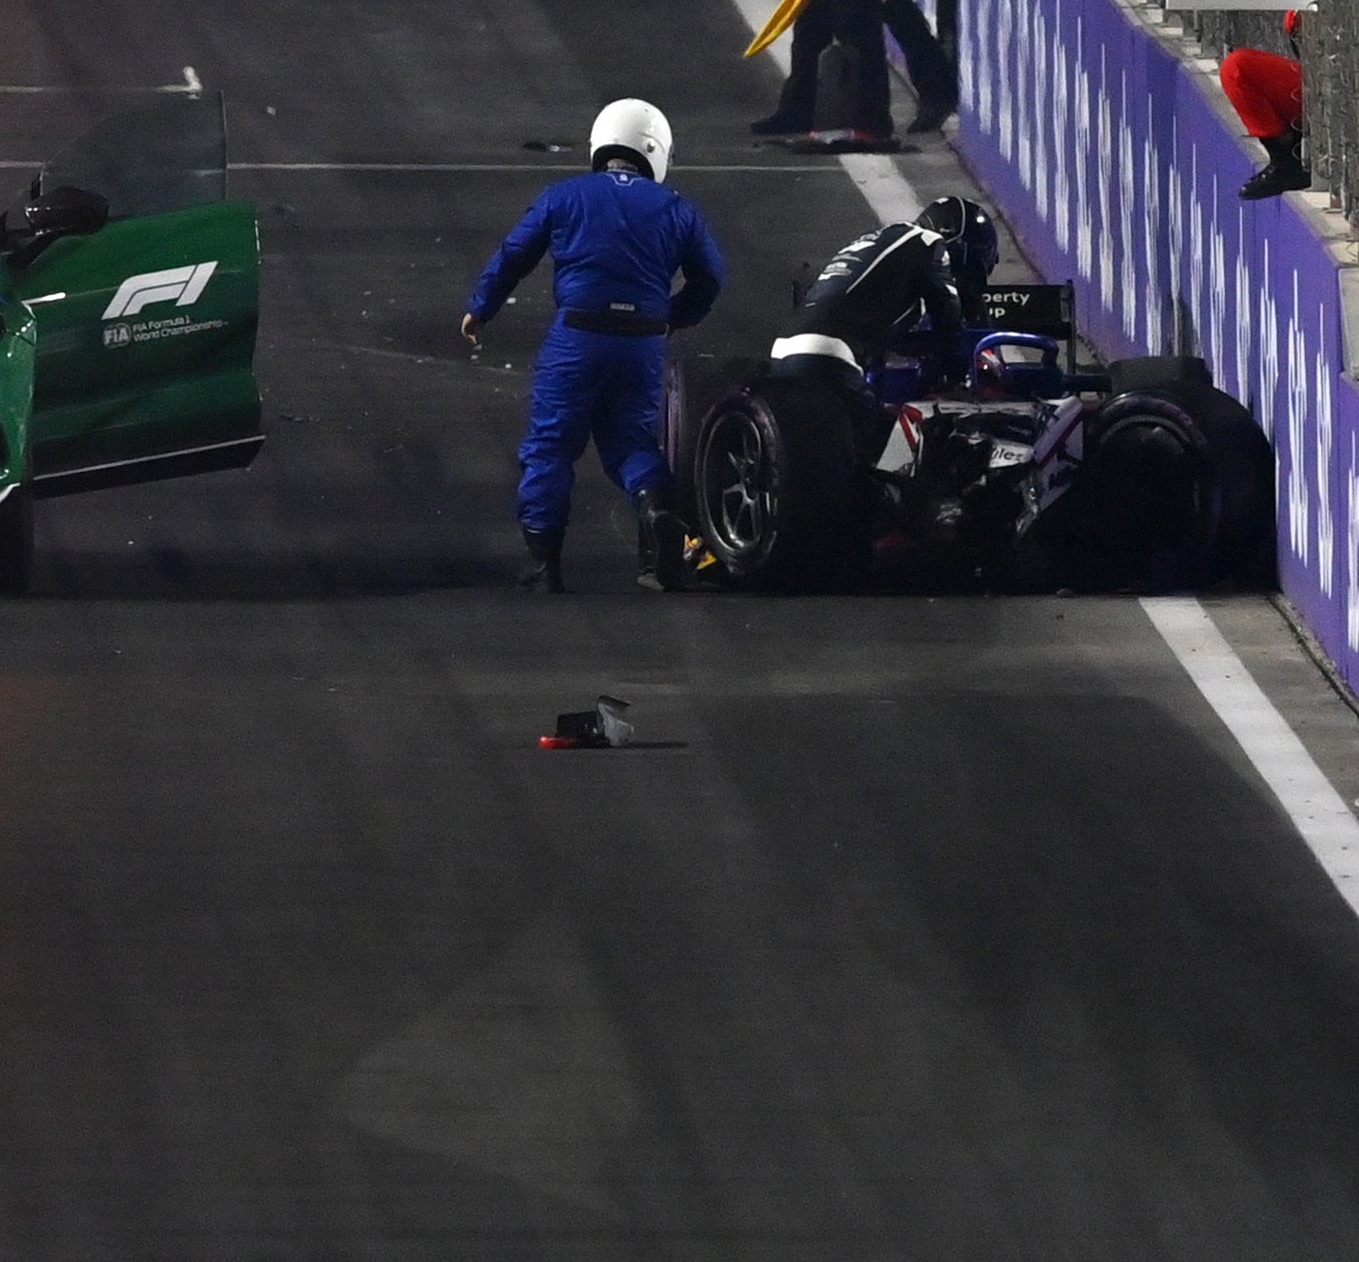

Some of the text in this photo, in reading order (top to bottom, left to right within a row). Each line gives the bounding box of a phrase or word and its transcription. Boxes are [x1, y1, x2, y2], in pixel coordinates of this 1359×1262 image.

[133, 321, 148, 332] FIA
[148, 317, 184, 330] Formula
[134, 329, 160, 342] World
